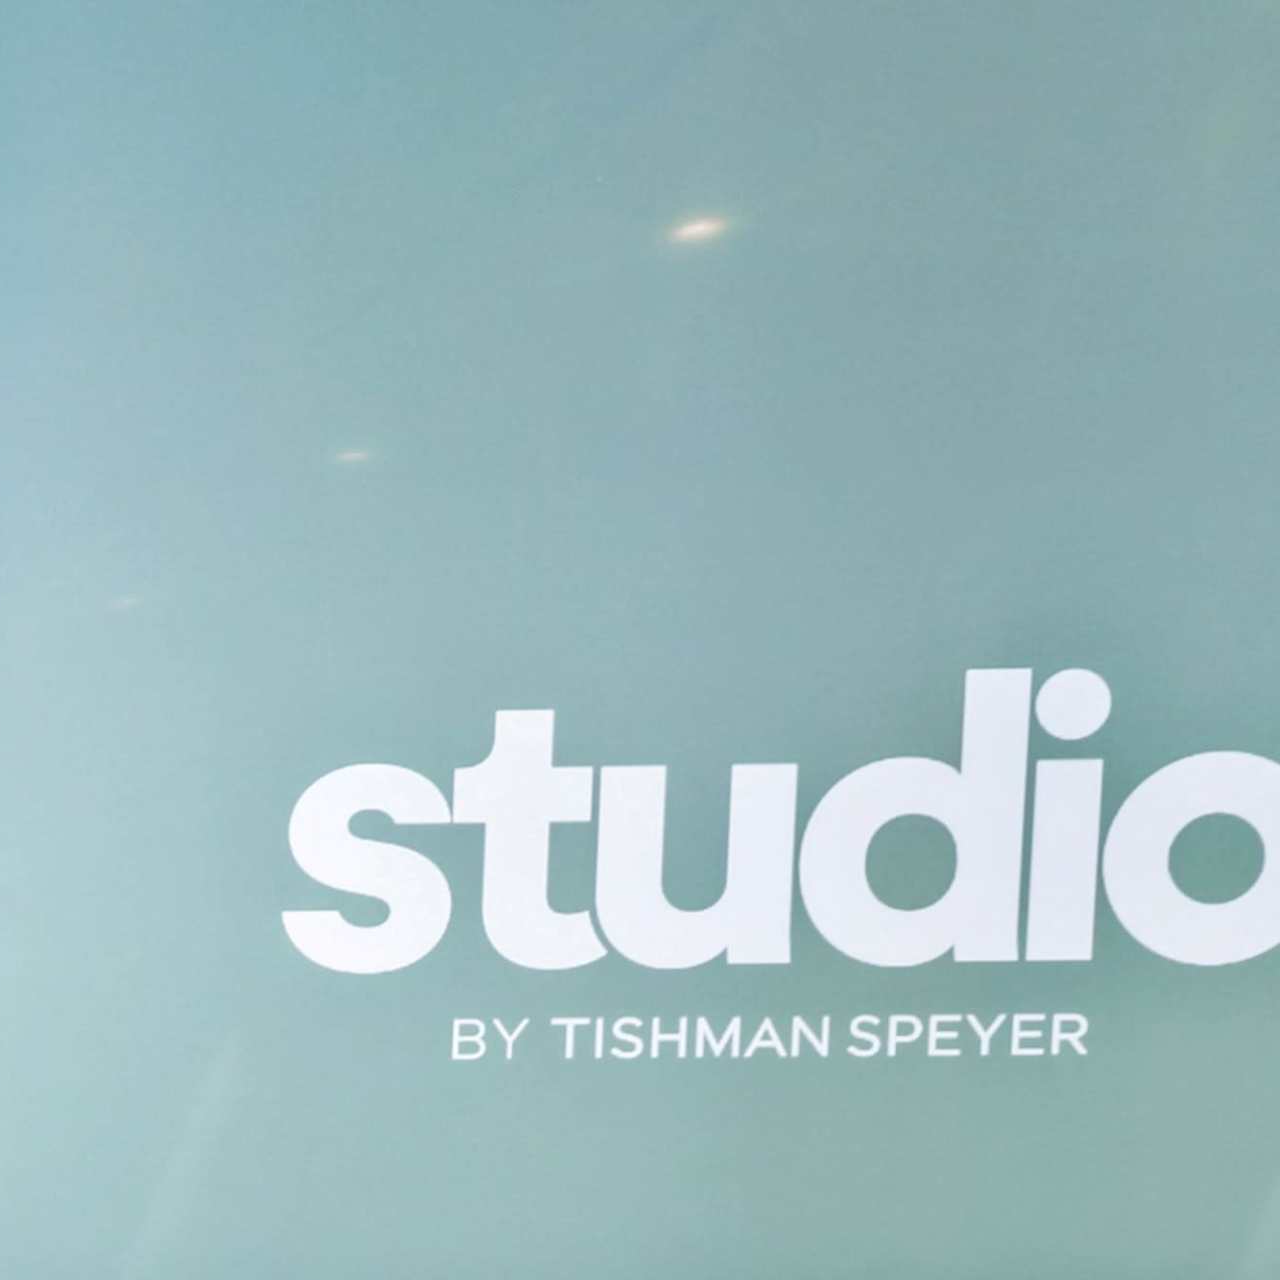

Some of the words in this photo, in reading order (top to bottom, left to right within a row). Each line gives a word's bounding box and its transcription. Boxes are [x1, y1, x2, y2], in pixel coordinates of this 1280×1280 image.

[281, 668, 1280, 974] studio
[451, 1017, 530, 1061] BY
[550, 1016, 830, 1059] TISHMAN
[847, 1013, 1089, 1058] SPEYER
